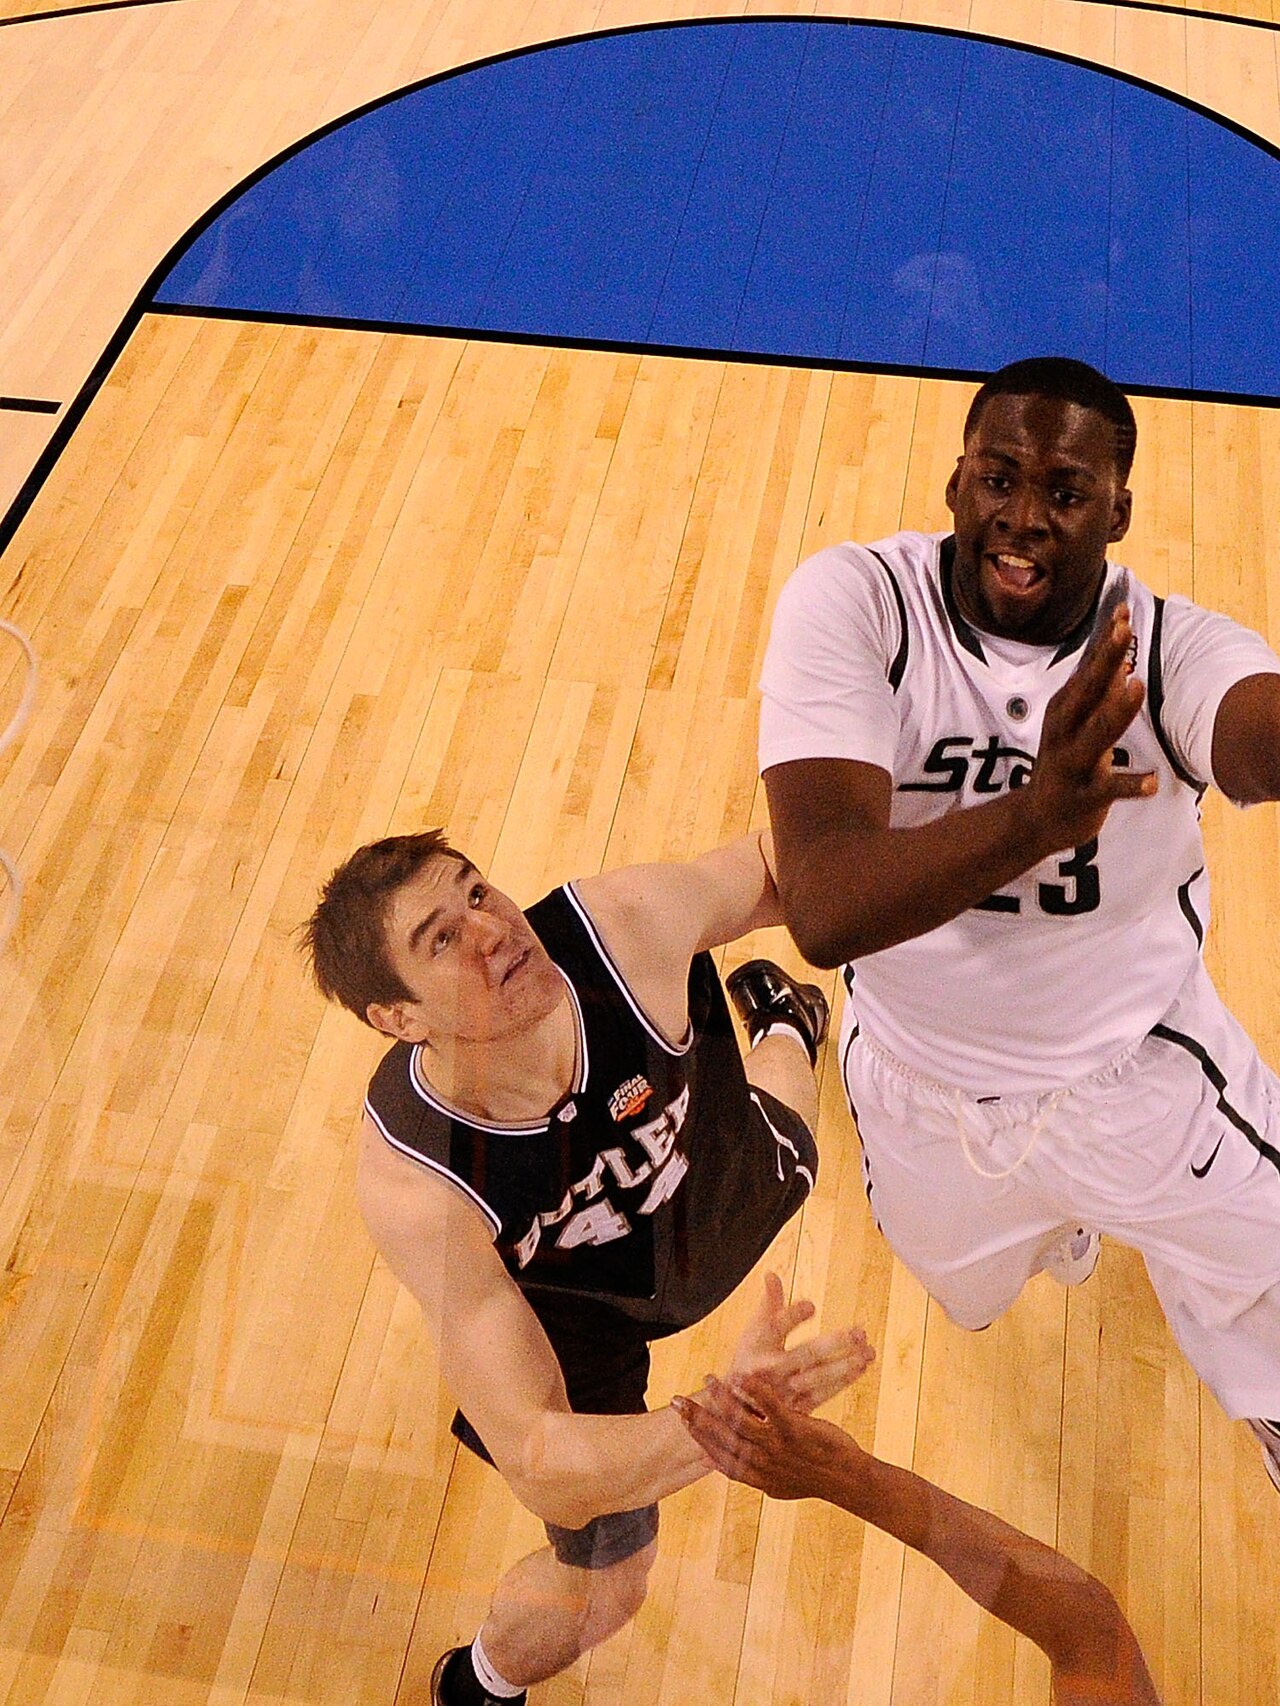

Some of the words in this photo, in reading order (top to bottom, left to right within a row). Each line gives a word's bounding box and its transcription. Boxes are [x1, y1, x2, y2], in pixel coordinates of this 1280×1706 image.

[971, 834, 1101, 916] 3
[610, 1079, 651, 1121] FOUR
[613, 1073, 644, 1101] FINAL
[513, 1083, 691, 1271] BUTLER
[554, 1149, 691, 1250] 44
